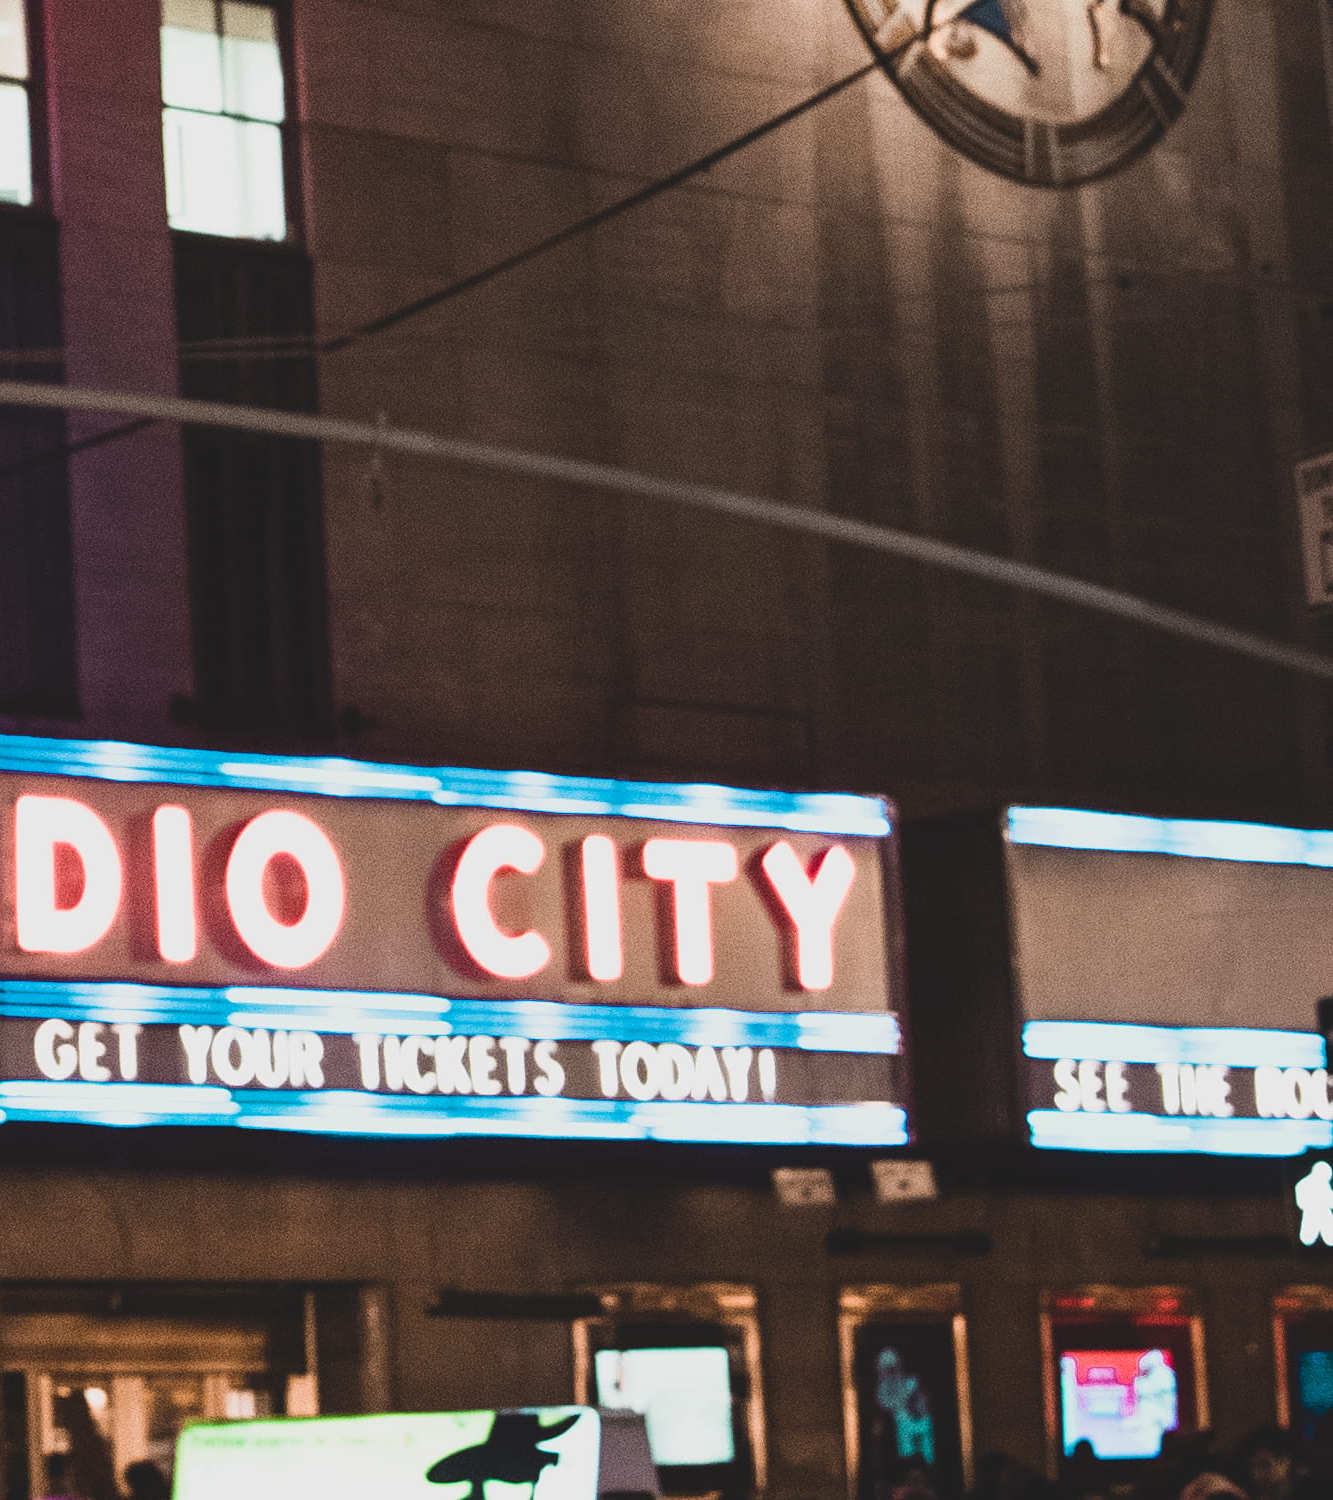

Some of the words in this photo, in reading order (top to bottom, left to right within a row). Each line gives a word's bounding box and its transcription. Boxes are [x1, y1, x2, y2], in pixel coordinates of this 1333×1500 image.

[452, 822, 857, 992] CITY
[34, 1017, 140, 1083] GET
[179, 1024, 325, 1091] YOUR
[351, 1031, 567, 1098] TICKETS
[591, 1039, 777, 1103] TODAY!
[1053, 1058, 1132, 1113] SEE
[1155, 1062, 1234, 1119] THE
